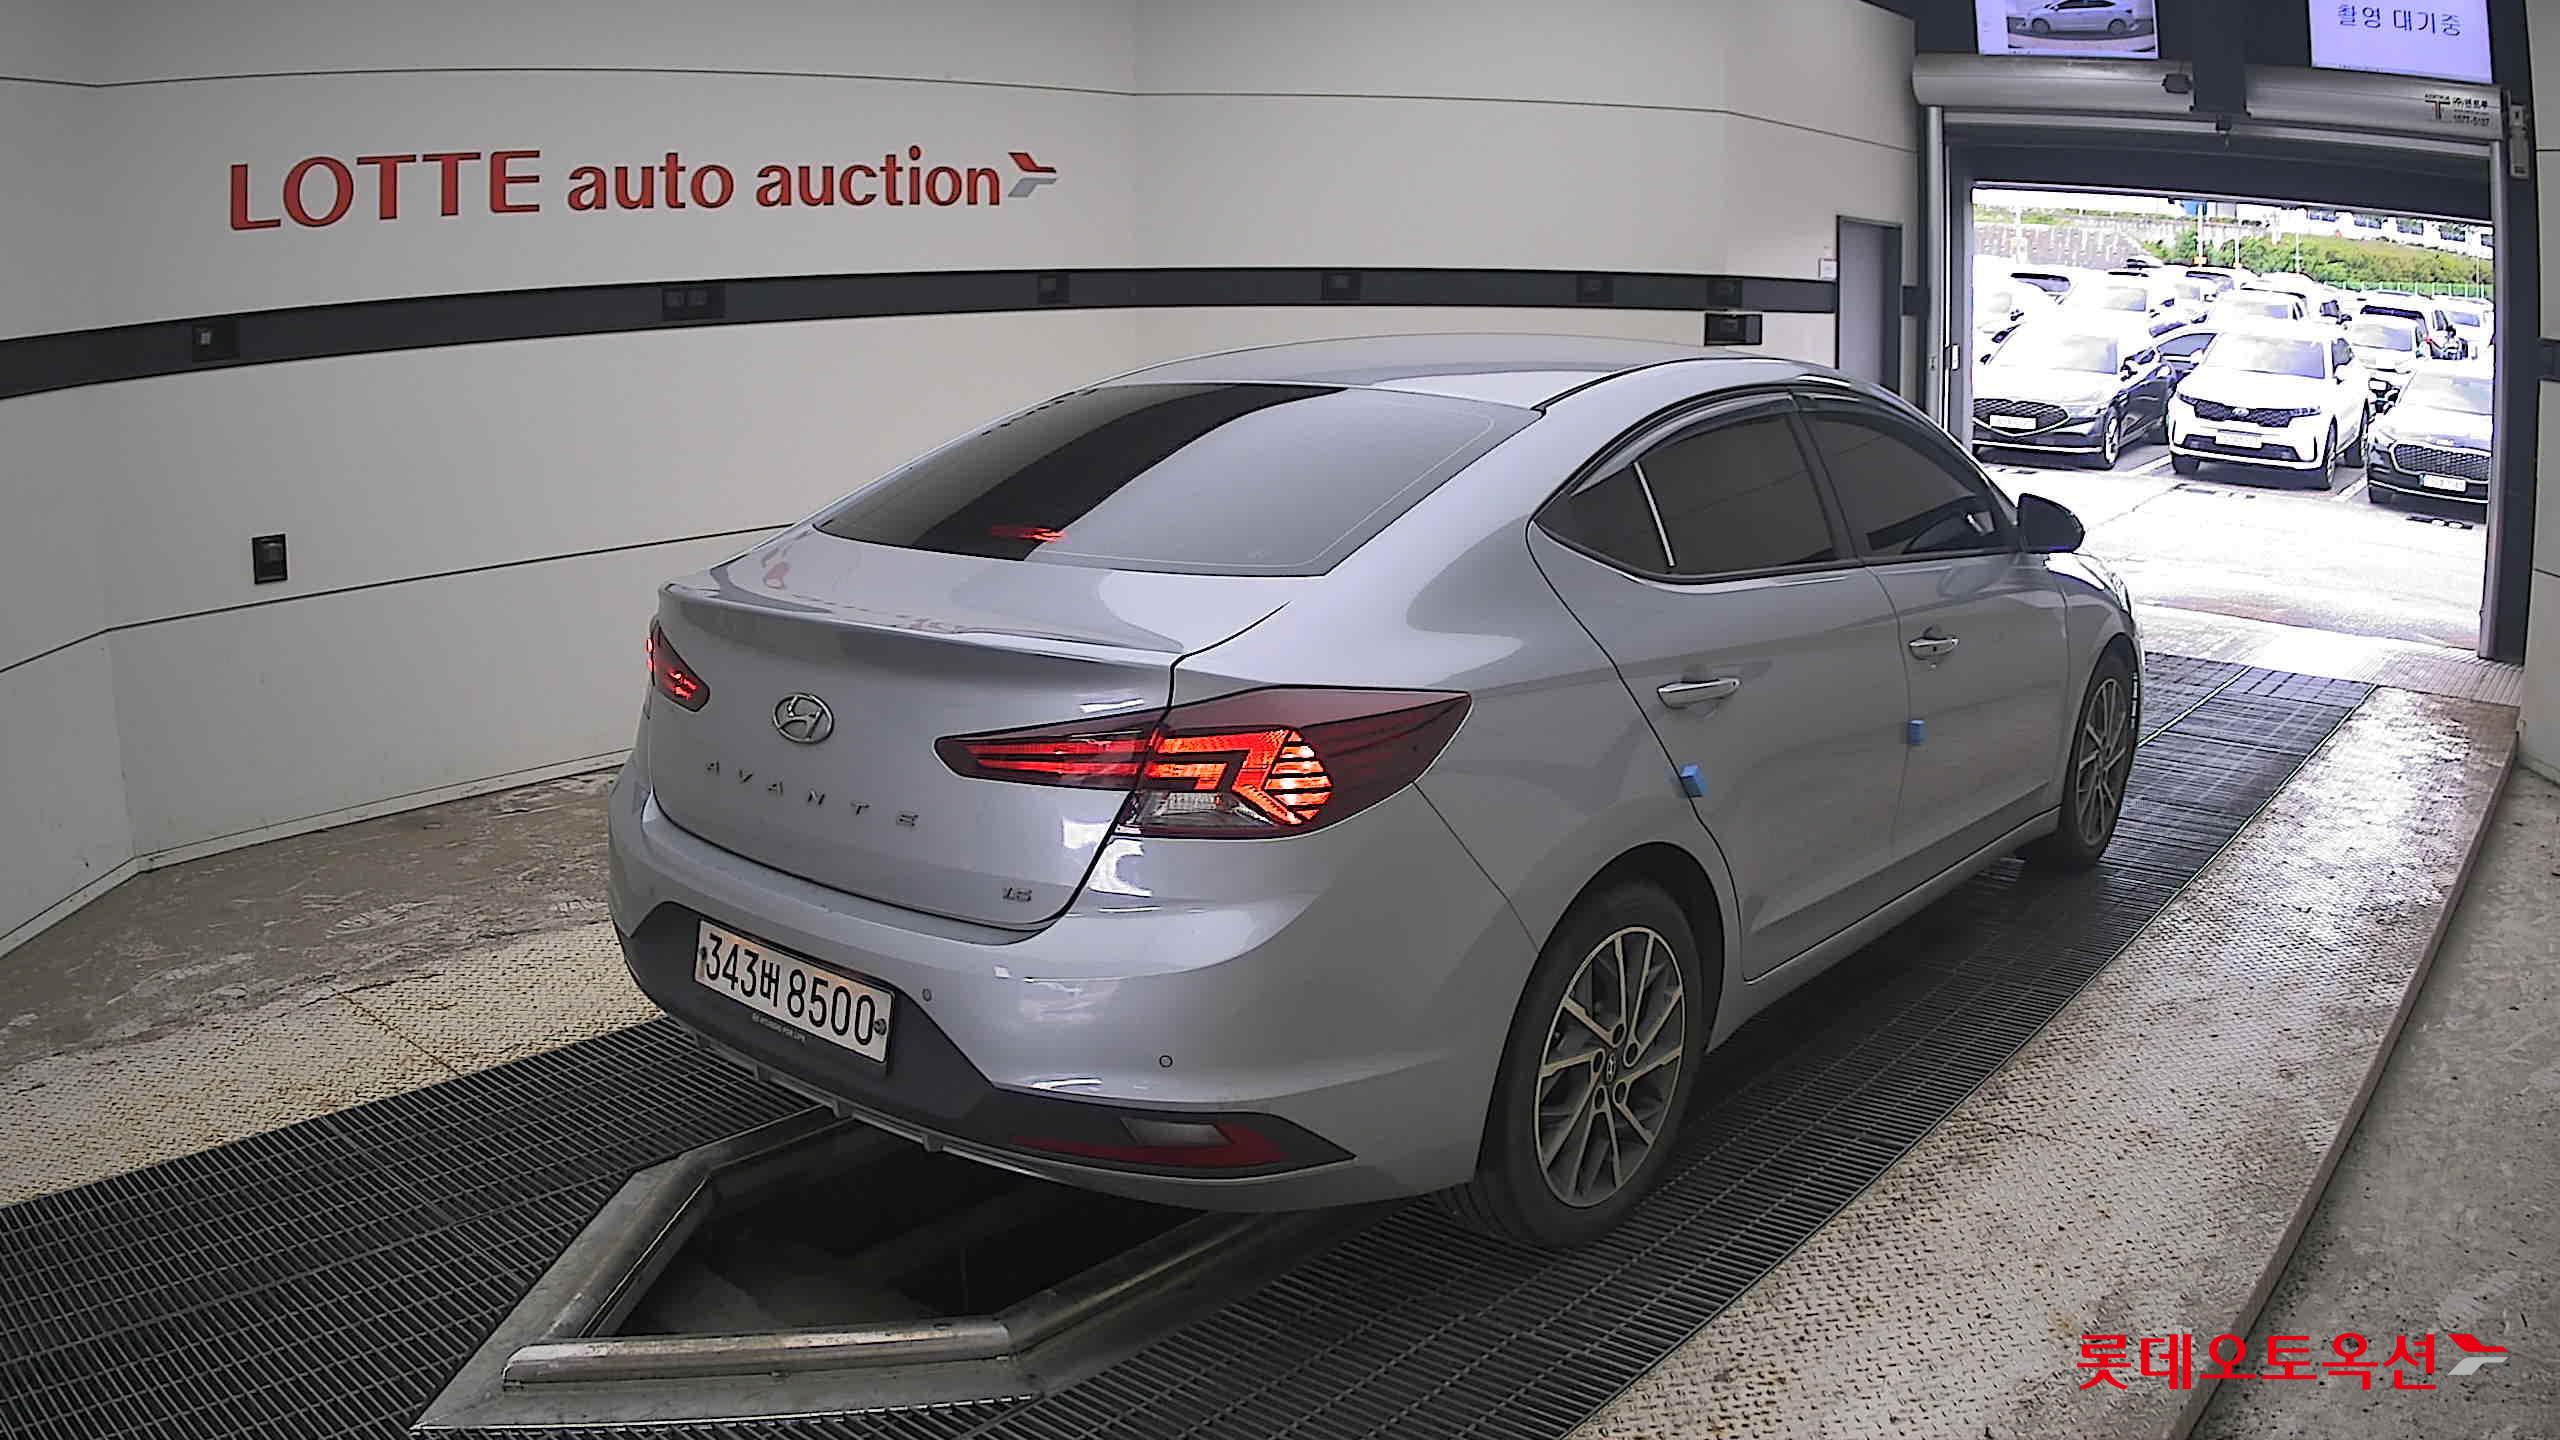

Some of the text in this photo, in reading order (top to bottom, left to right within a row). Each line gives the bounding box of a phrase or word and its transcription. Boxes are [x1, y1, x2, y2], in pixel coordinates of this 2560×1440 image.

[2338, 4, 2461, 36] 촬영 대기중
[230, 146, 1001, 230] LOTTE auto auction
[705, 759, 919, 827] AVANTE
[705, 932, 780, 1007] 343버
[787, 969, 875, 1046] 8500
